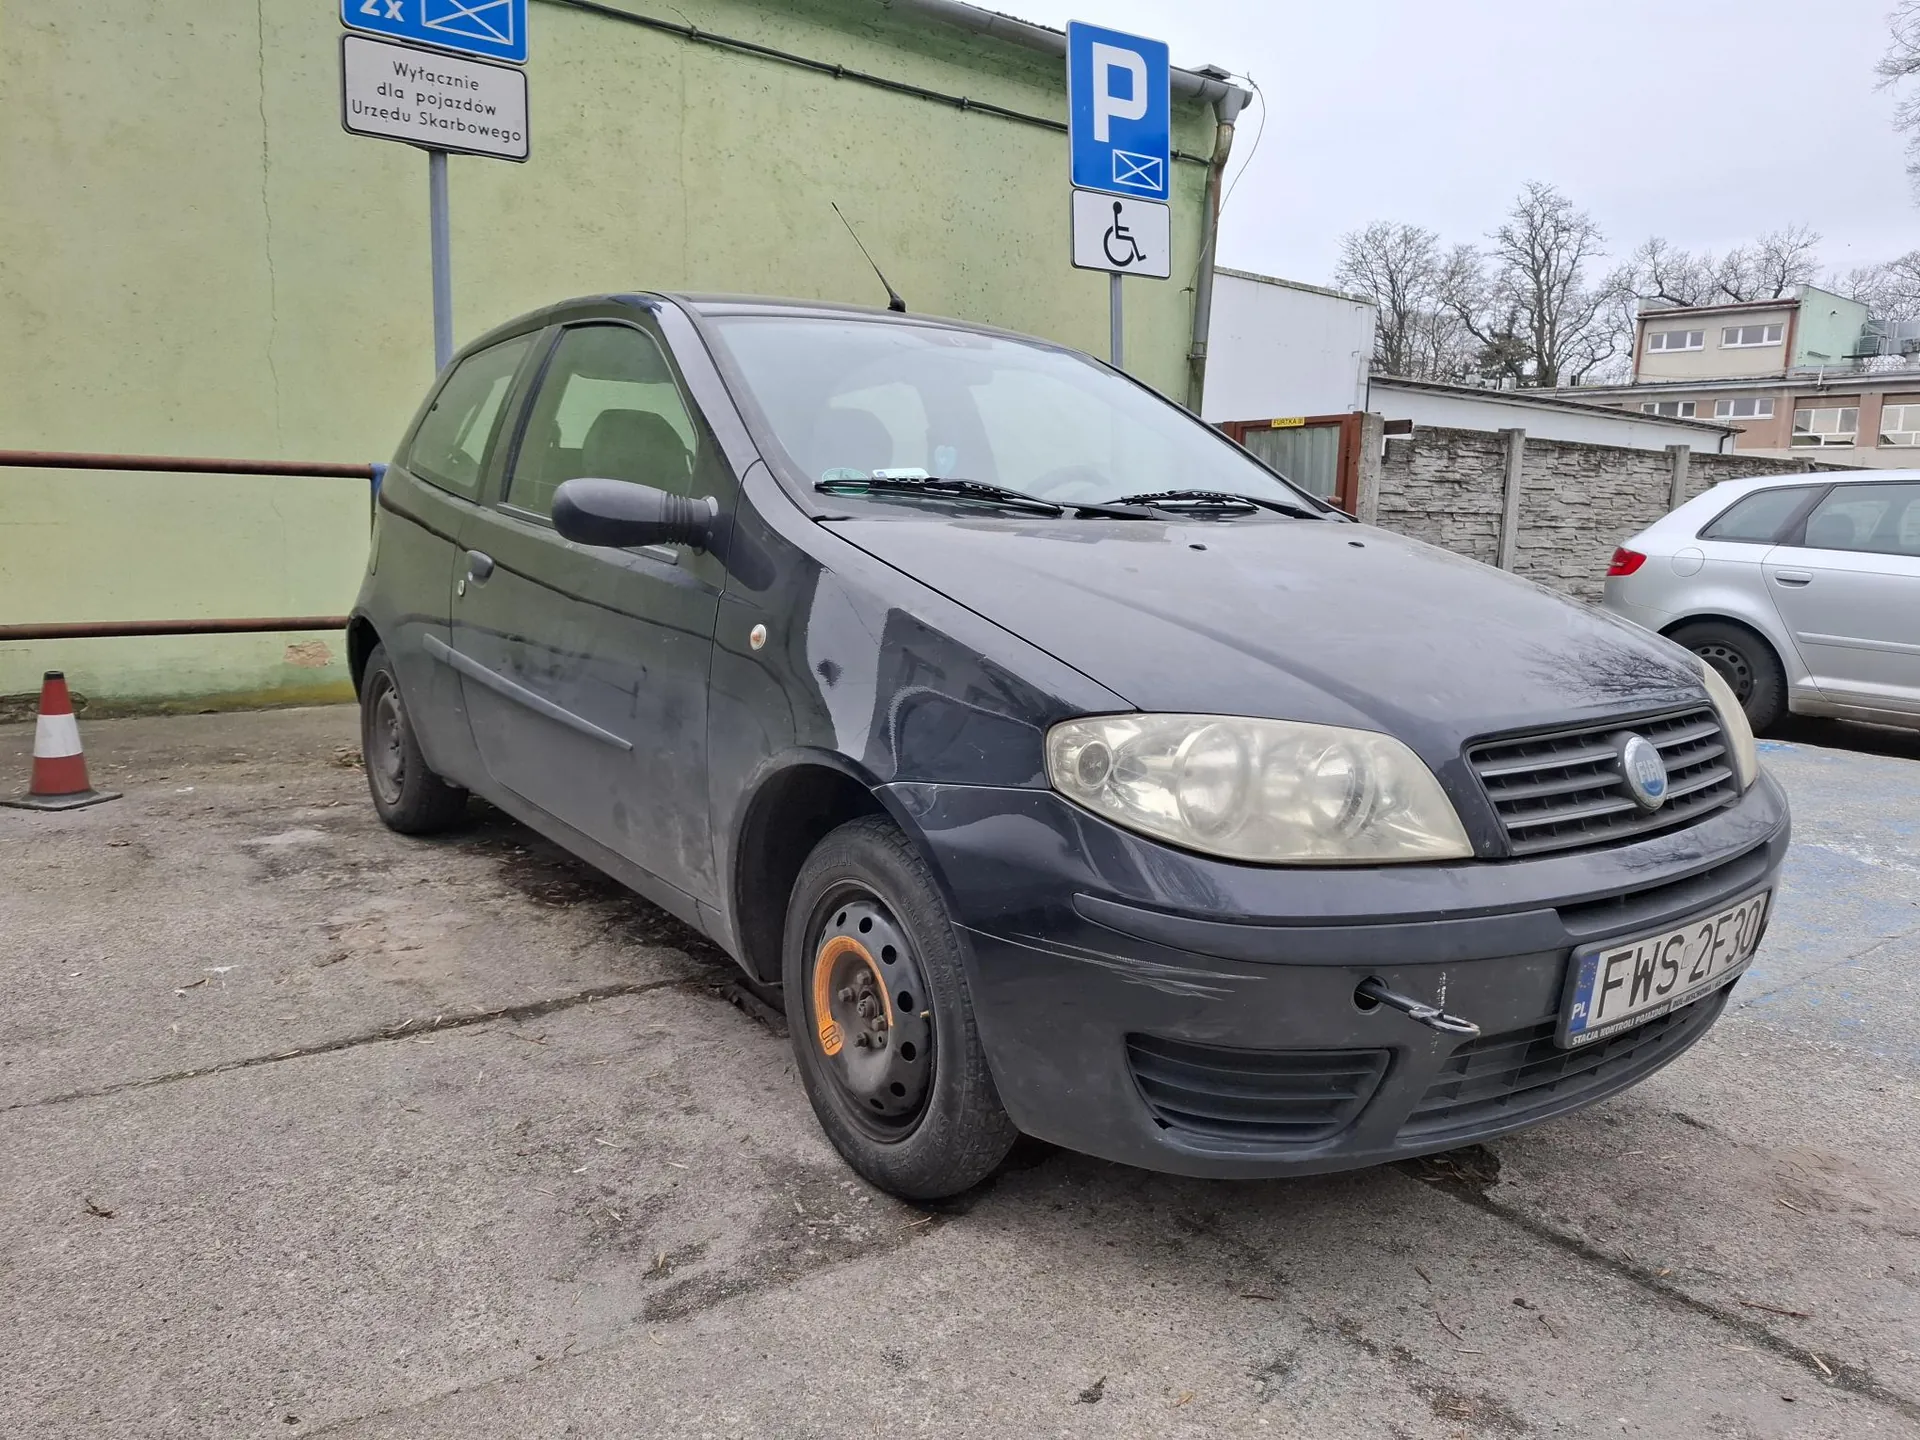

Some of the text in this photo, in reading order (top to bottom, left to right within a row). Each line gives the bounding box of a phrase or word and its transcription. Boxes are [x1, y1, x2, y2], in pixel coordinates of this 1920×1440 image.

[392, 60, 480, 91] Wyłącznie
[1092, 41, 1148, 143] P
[376, 82, 497, 116] dla pojazdów
[351, 99, 522, 143] Urzędu Skarbowego
[1596, 934, 1685, 1019] FWS
[1688, 900, 1761, 984] 2F30
[1571, 1001, 1587, 1020] PL
[1572, 1030, 1599, 1046] STACJA
[1600, 1017, 1634, 1037] KONTROLI
